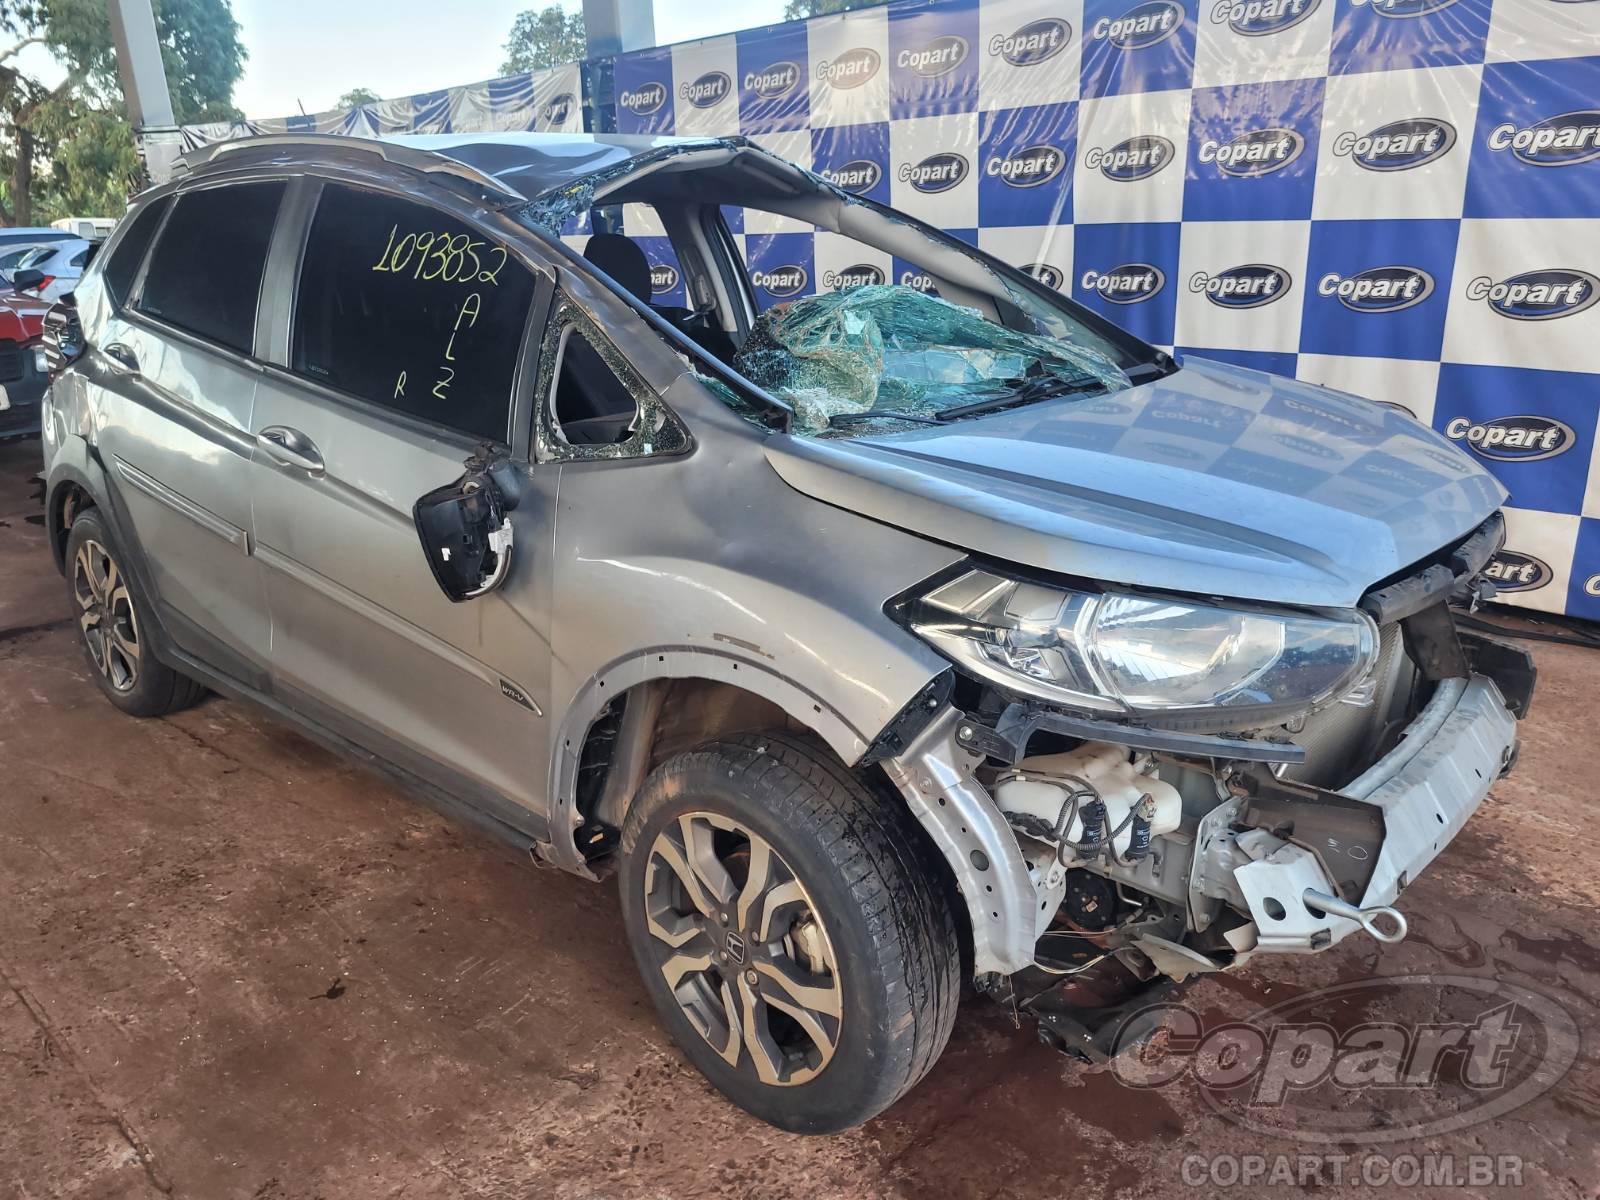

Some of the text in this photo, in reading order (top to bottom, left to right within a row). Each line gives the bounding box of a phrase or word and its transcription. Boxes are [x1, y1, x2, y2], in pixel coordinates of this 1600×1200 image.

[1093, 5, 1174, 40] Copart
[989, 25, 1060, 56] Copart
[816, 56, 871, 81] Copart
[897, 42, 959, 70] Copart
[680, 77, 723, 98] Copart
[744, 67, 793, 91] Copart
[620, 88, 661, 108] Copart
[1085, 143, 1160, 172] Copart
[1199, 134, 1290, 168] Copart
[1333, 127, 1440, 161] Copart
[898, 158, 959, 185] Copart
[987, 151, 1057, 179] Copart
[372, 224, 507, 286] 1093852
[752, 271, 800, 290] Copart
[823, 270, 876, 287] Copart
[1081, 271, 1154, 295] Copart
[1189, 270, 1278, 298] Copart
[1318, 272, 1421, 302] Copart
[1466, 276, 1587, 308] Copart
[394, 370, 407, 399] R
[1445, 416, 1559, 450] Copart
